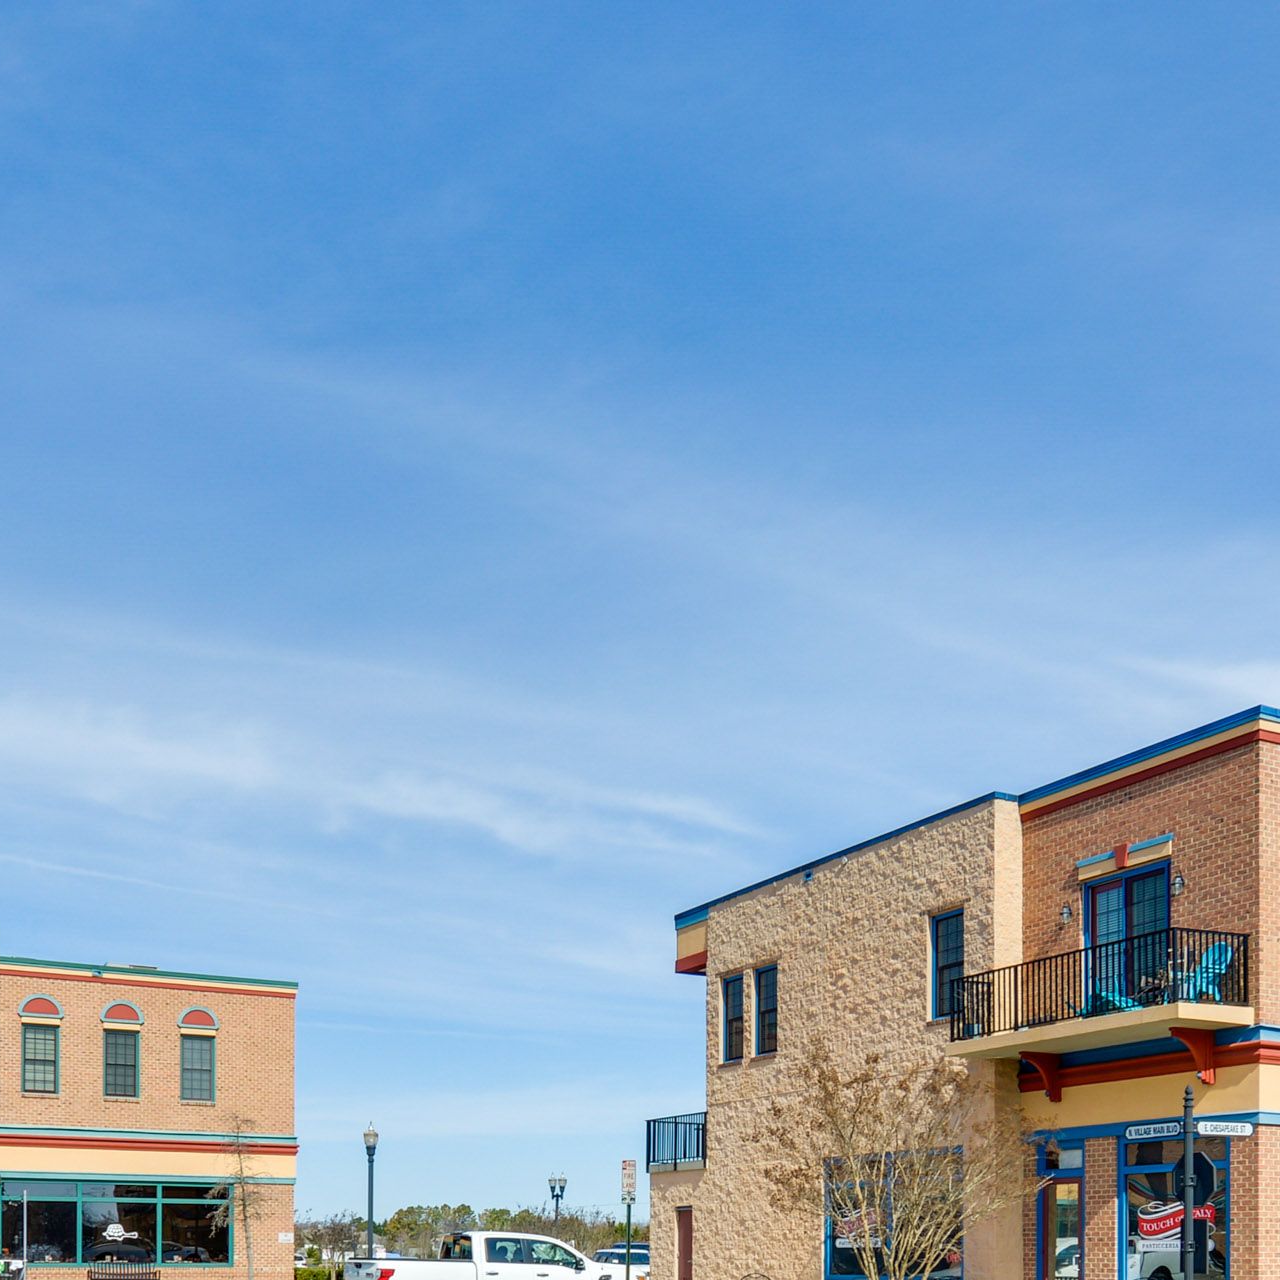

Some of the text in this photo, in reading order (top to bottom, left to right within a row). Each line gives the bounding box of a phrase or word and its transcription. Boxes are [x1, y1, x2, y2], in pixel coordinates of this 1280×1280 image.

[1133, 1126, 1152, 1136] VILLAGE
[1152, 1125, 1166, 1135] MAIN
[1166, 1123, 1178, 1134] BLVD
[1210, 1123, 1239, 1134] CHESAPEAKE
[1141, 1217, 1174, 1232] TOUCH
